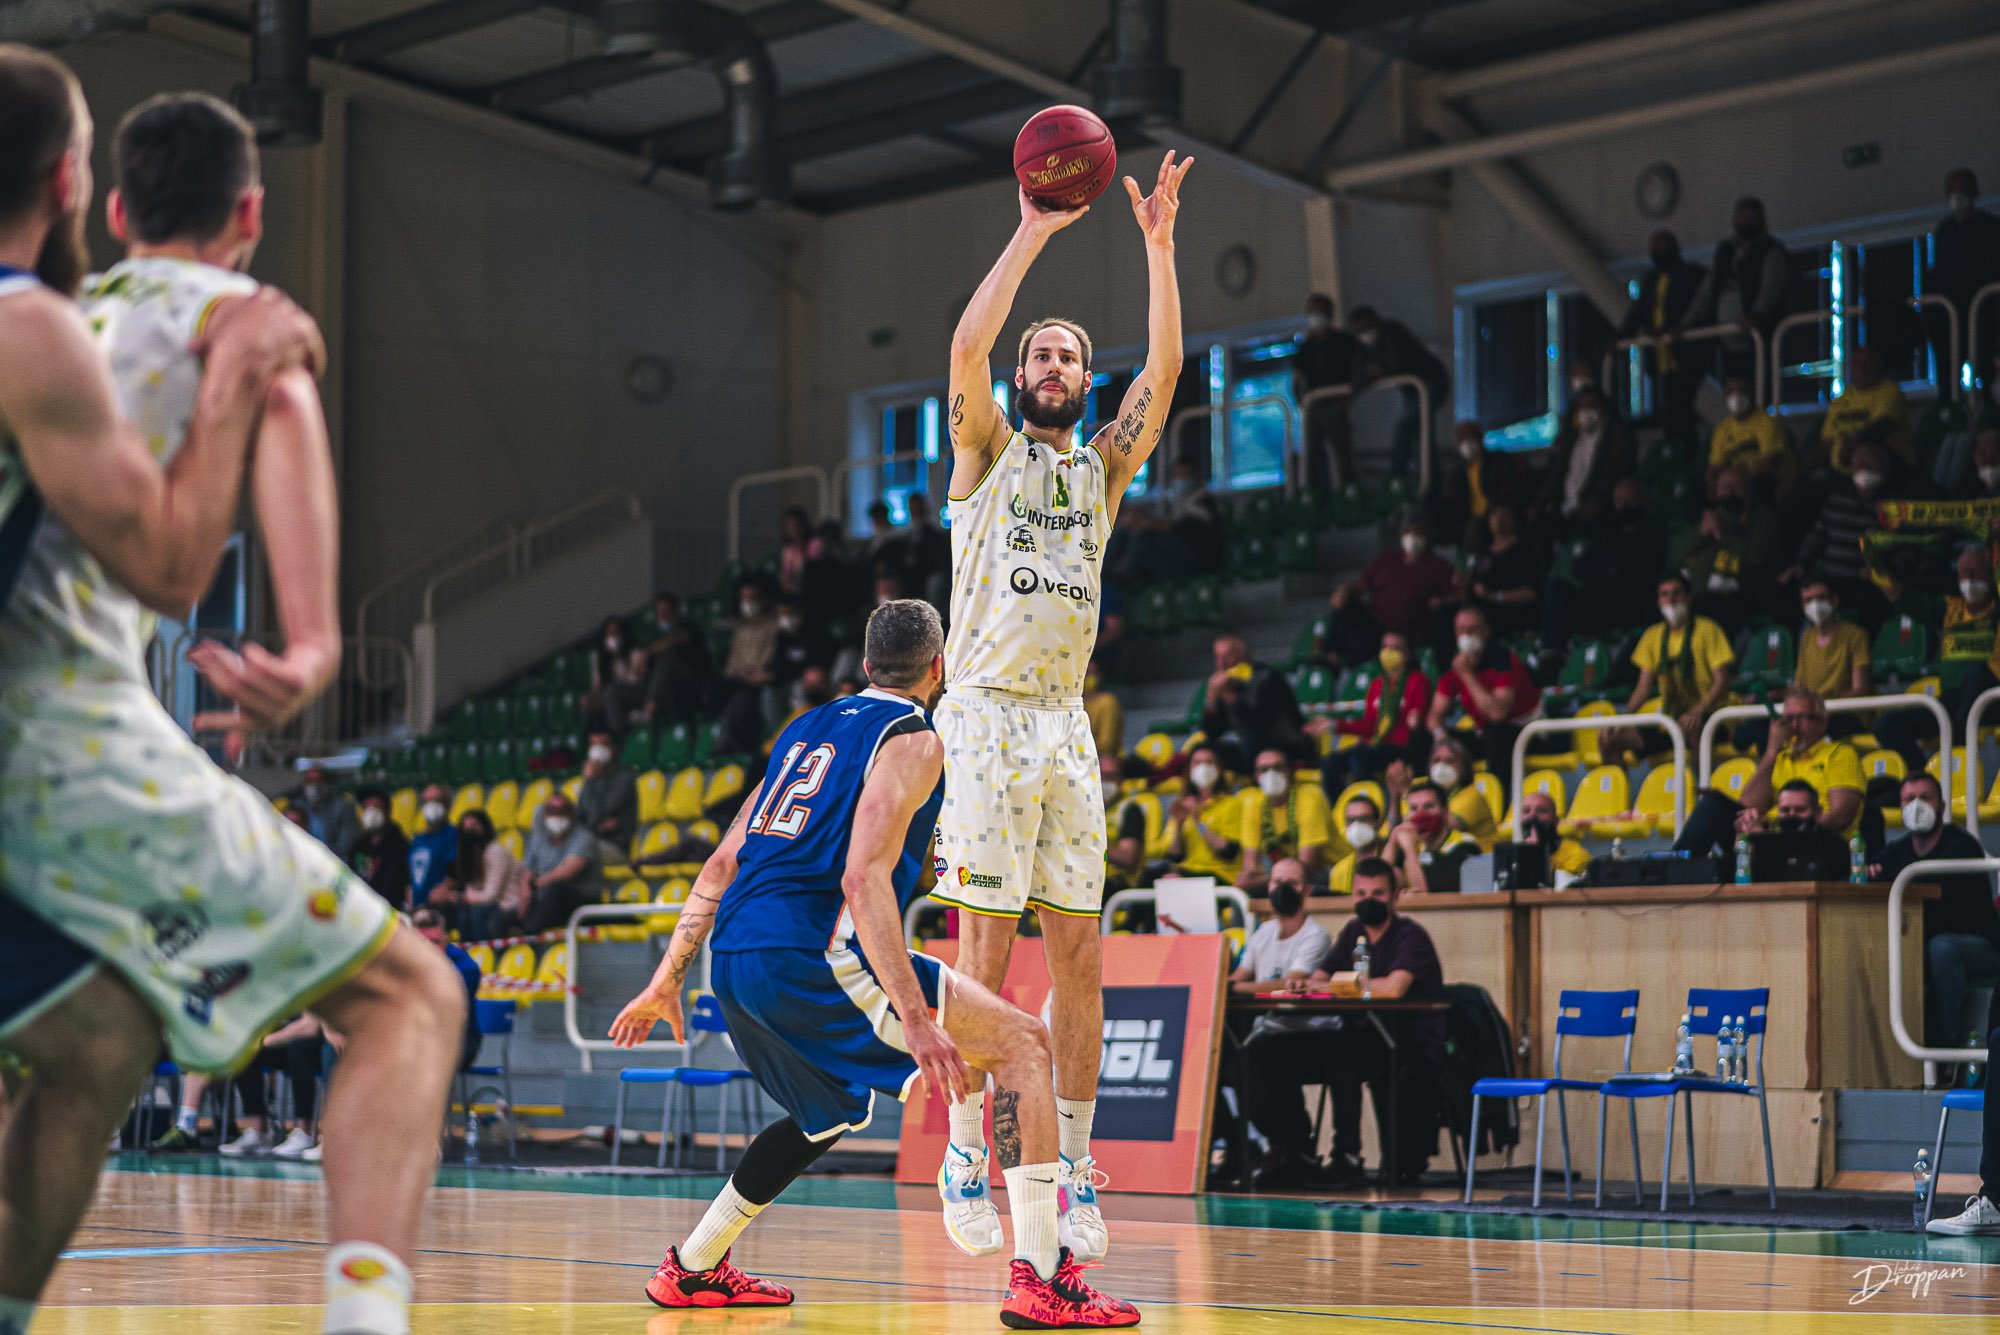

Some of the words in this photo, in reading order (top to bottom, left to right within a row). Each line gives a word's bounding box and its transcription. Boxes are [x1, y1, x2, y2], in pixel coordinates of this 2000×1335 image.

[1043, 577, 1093, 604] VEOL
[748, 741, 836, 840] 12
[971, 873, 1002, 882] PATRIOTI
